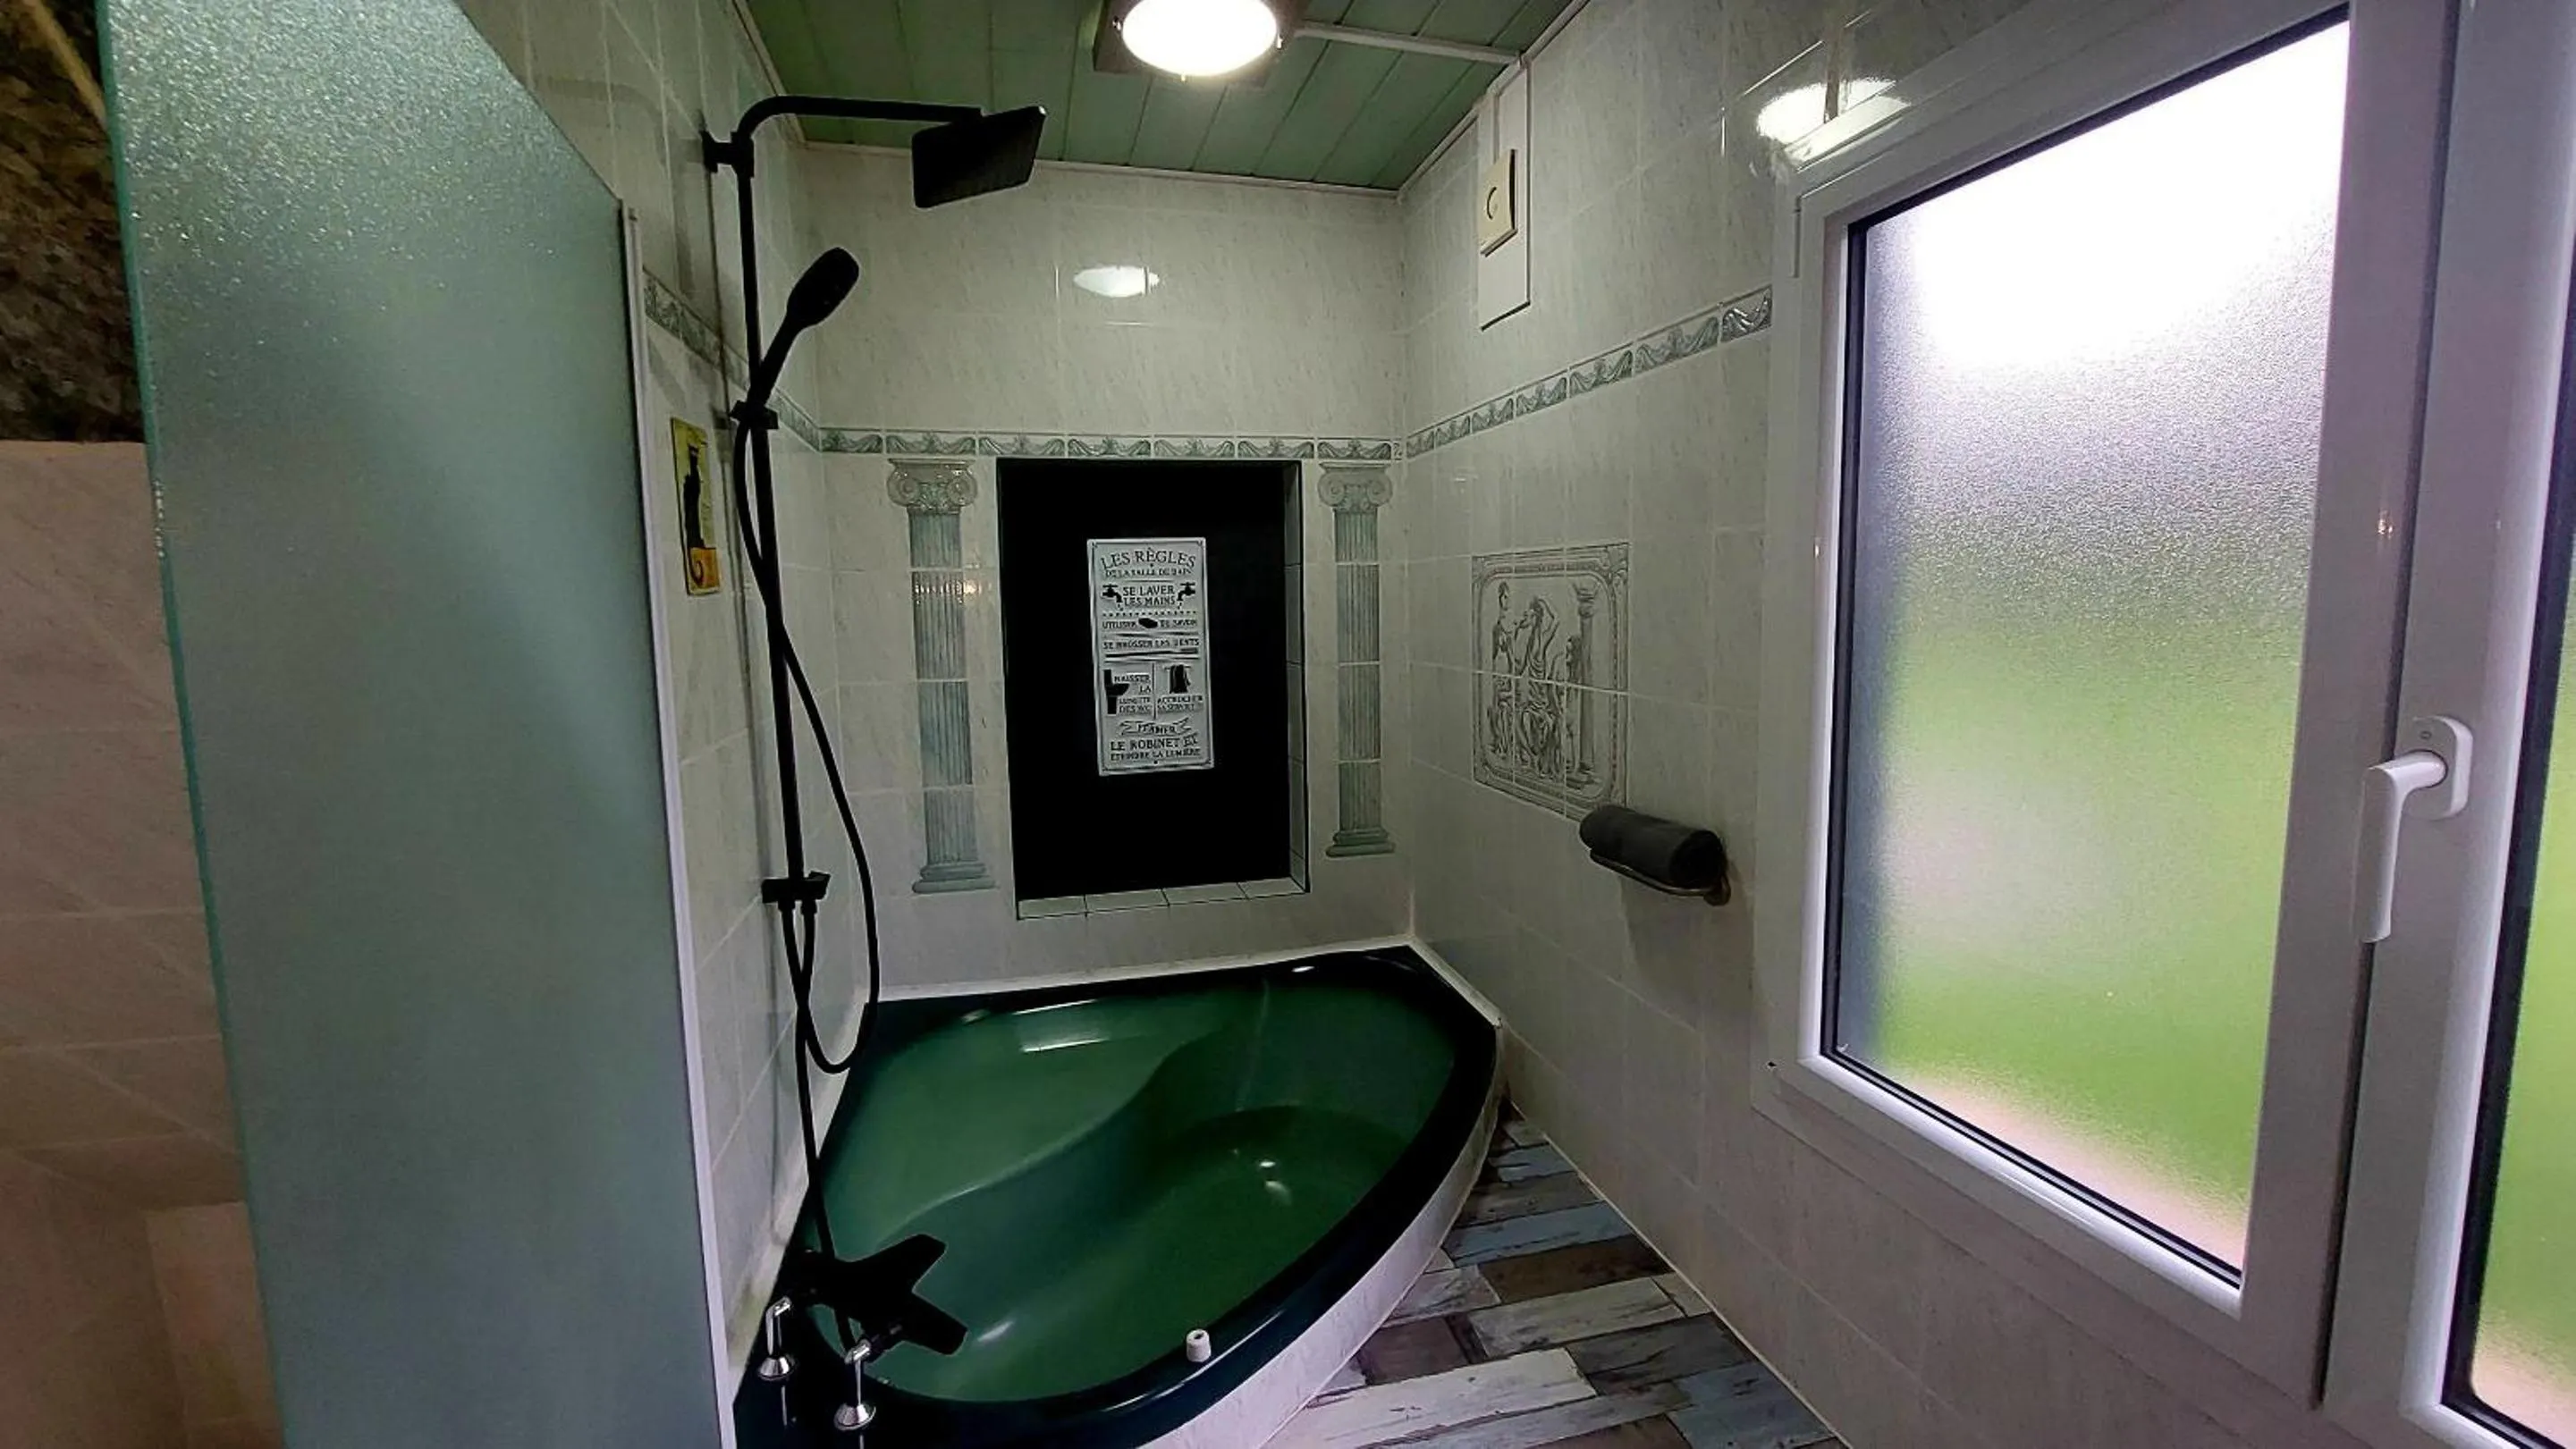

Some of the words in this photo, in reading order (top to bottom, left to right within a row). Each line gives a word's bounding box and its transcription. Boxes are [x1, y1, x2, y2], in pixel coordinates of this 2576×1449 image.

[1101, 552, 1130, 569] LES
[1135, 547, 1196, 569] RÈGLES
[1123, 586, 1136, 596] SE
[1140, 585, 1175, 596] LAVER
[1124, 597, 1142, 607] LES
[1145, 596, 1175, 605] MAINS
[1111, 742, 1125, 751] LE
[1130, 738, 1180, 749] ROBINET
